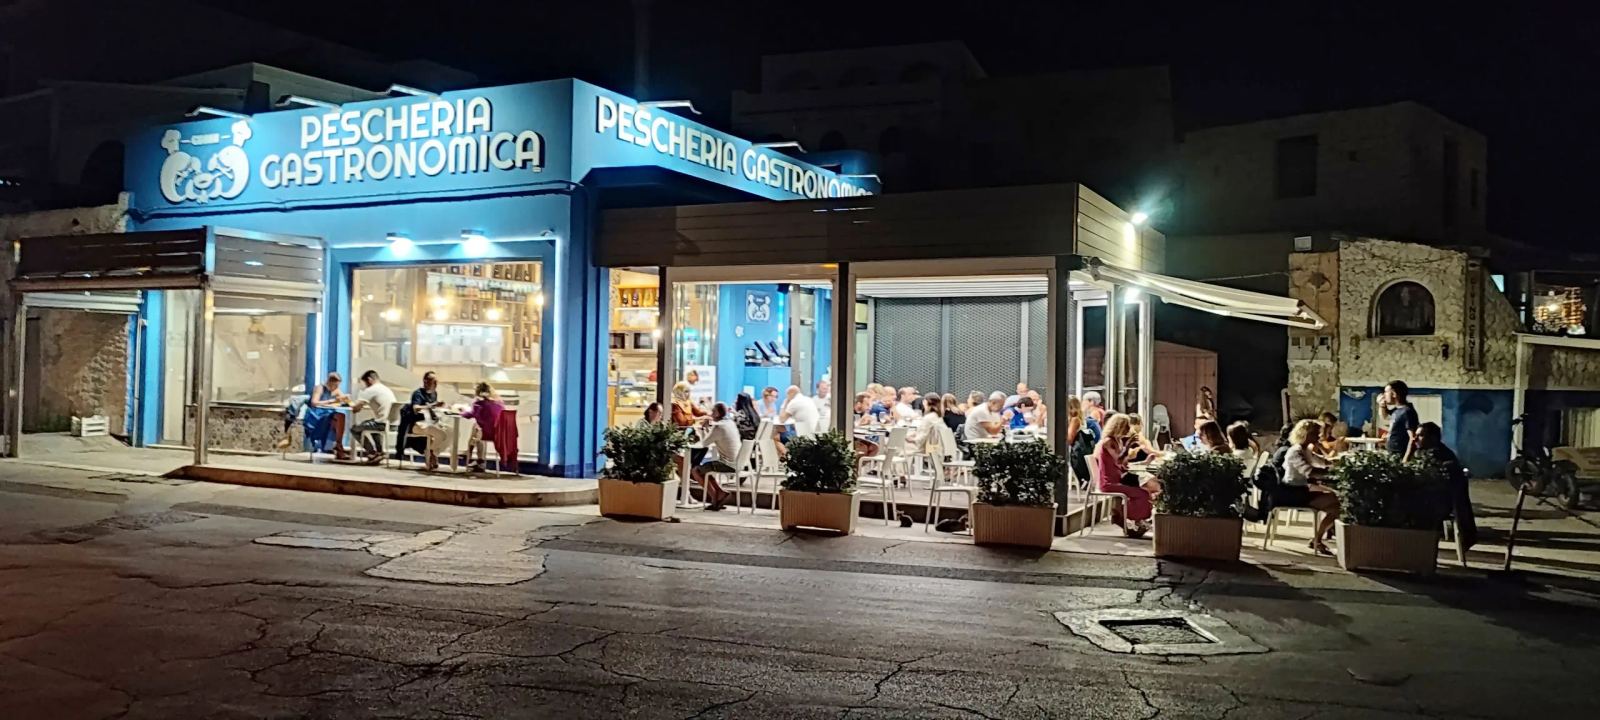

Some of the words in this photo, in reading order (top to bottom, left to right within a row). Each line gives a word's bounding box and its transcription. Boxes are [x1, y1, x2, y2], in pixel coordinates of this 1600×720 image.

[300, 96, 493, 149] PESCHERIA
[596, 97, 737, 175] PESCHERIA
[743, 149, 873, 199] GASTRONOM
[259, 130, 544, 188] GASTRONOMICA
